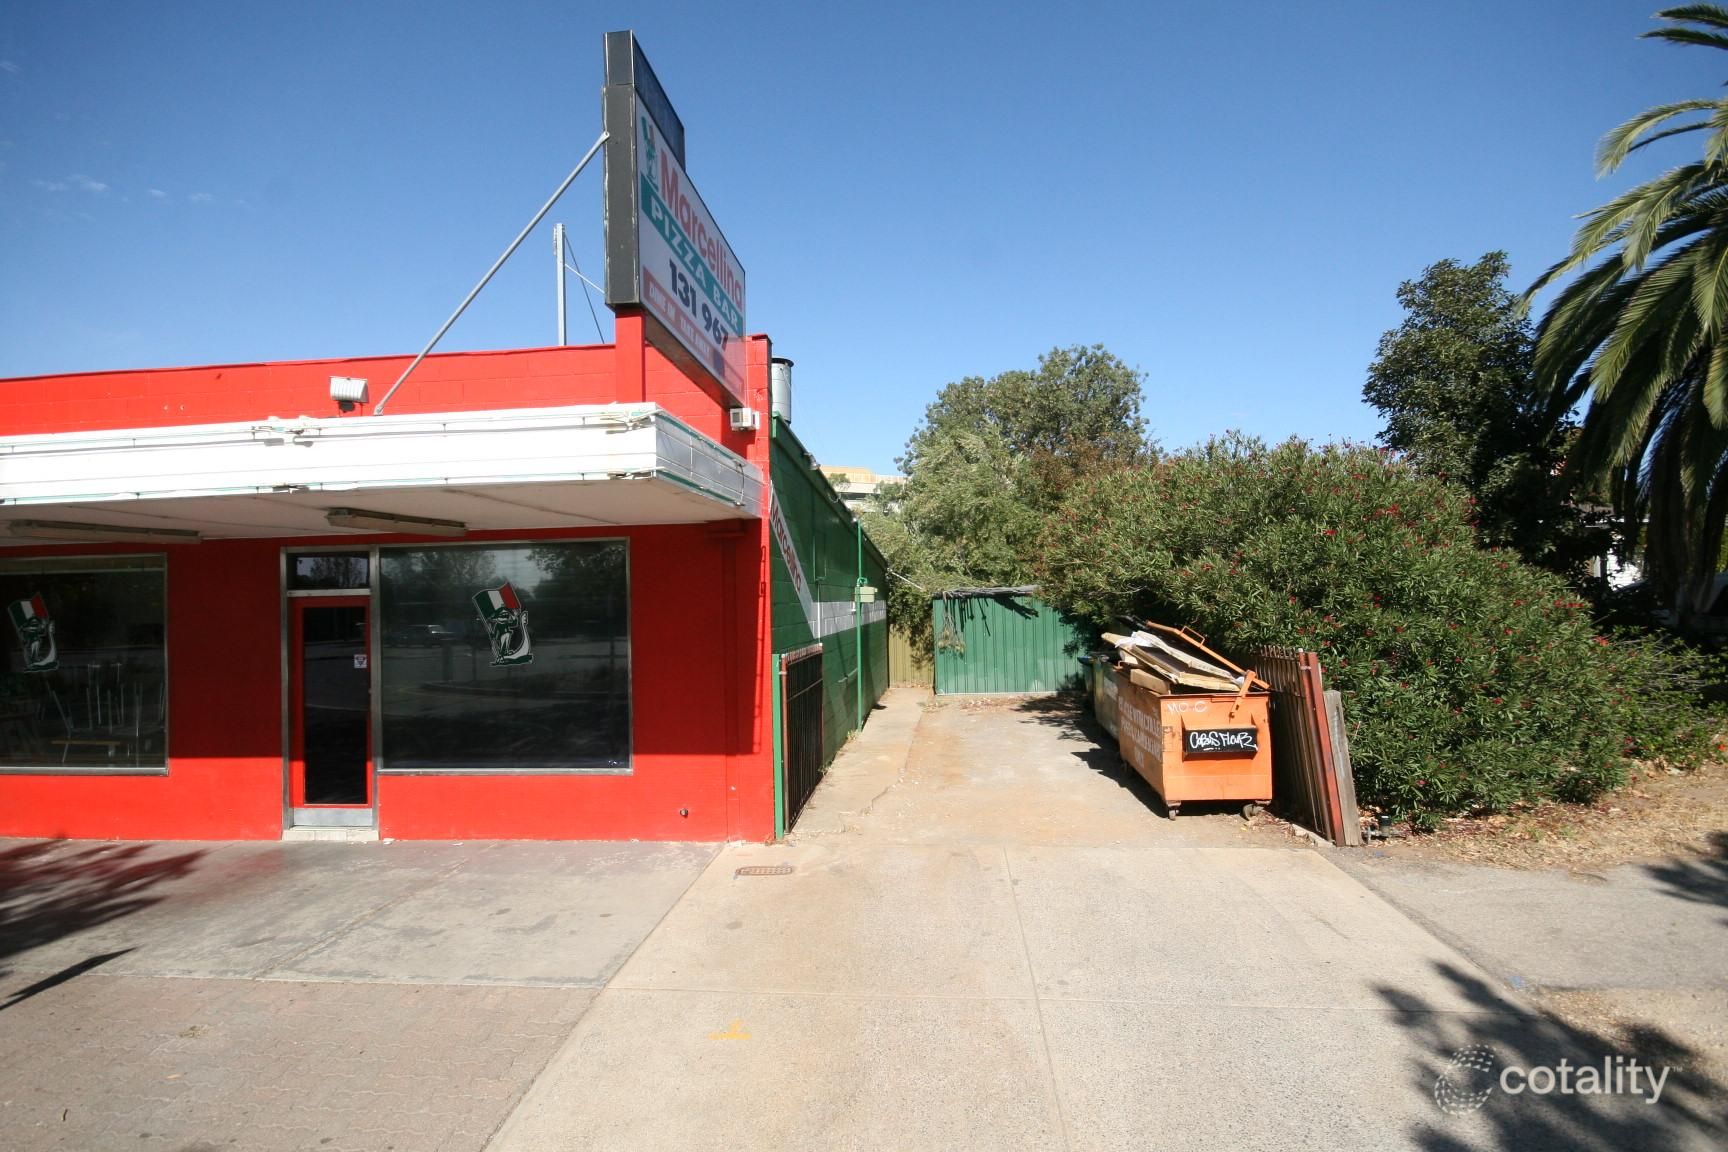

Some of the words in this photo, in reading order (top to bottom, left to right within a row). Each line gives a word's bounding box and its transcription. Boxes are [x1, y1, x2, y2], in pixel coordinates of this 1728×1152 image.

[651, 194, 706, 288] PIZZA
[713, 284, 738, 328] BAR
[660, 147, 743, 311] Marcellina
[669, 257, 697, 318] 131
[702, 303, 729, 351] 967
